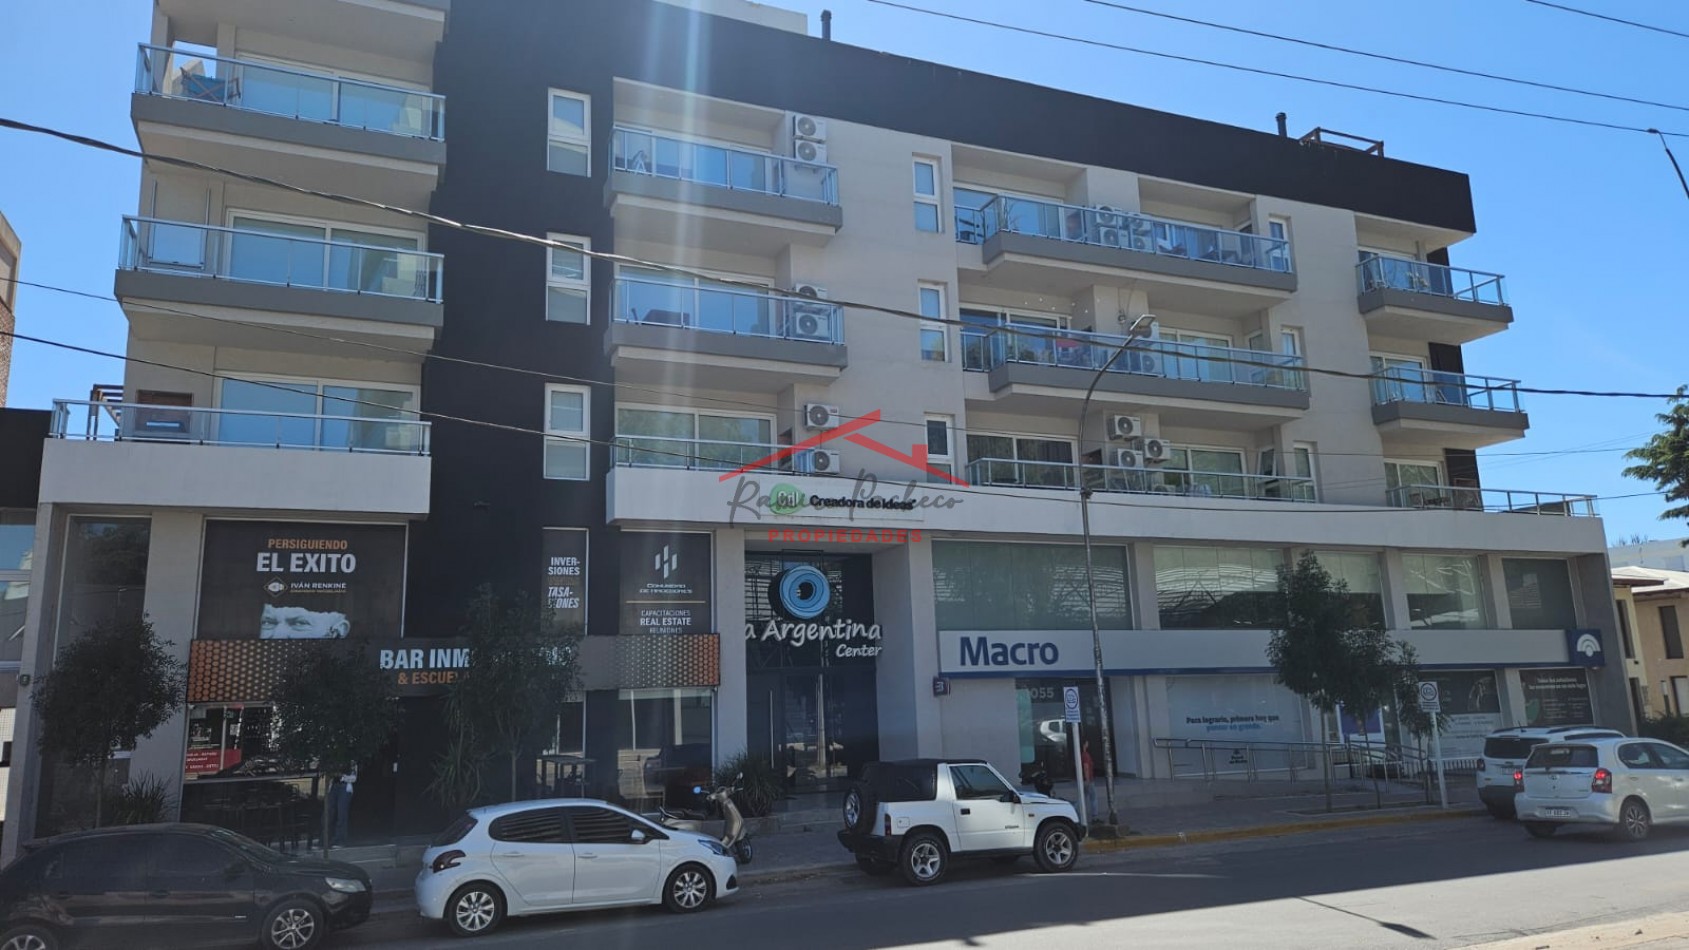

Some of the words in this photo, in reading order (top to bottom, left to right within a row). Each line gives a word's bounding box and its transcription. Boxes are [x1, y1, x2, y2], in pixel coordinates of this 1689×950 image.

[810, 494, 865, 509] Creadora
[866, 497, 882, 509] de
[267, 538, 348, 551] PERSIGUIENDO
[256, 552, 284, 572] EL
[289, 552, 357, 573] EXITO
[551, 556, 581, 567] INVER-
[548, 566, 580, 576] SIONES
[548, 586, 574, 598] TASA-
[640, 617, 661, 626] REAL
[662, 617, 692, 626] ESTATE
[761, 618, 882, 647] Argentina
[835, 643, 883, 658] Center
[960, 636, 1060, 666] Macro
[380, 649, 424, 669] BAR
[398, 672, 408, 685] &
